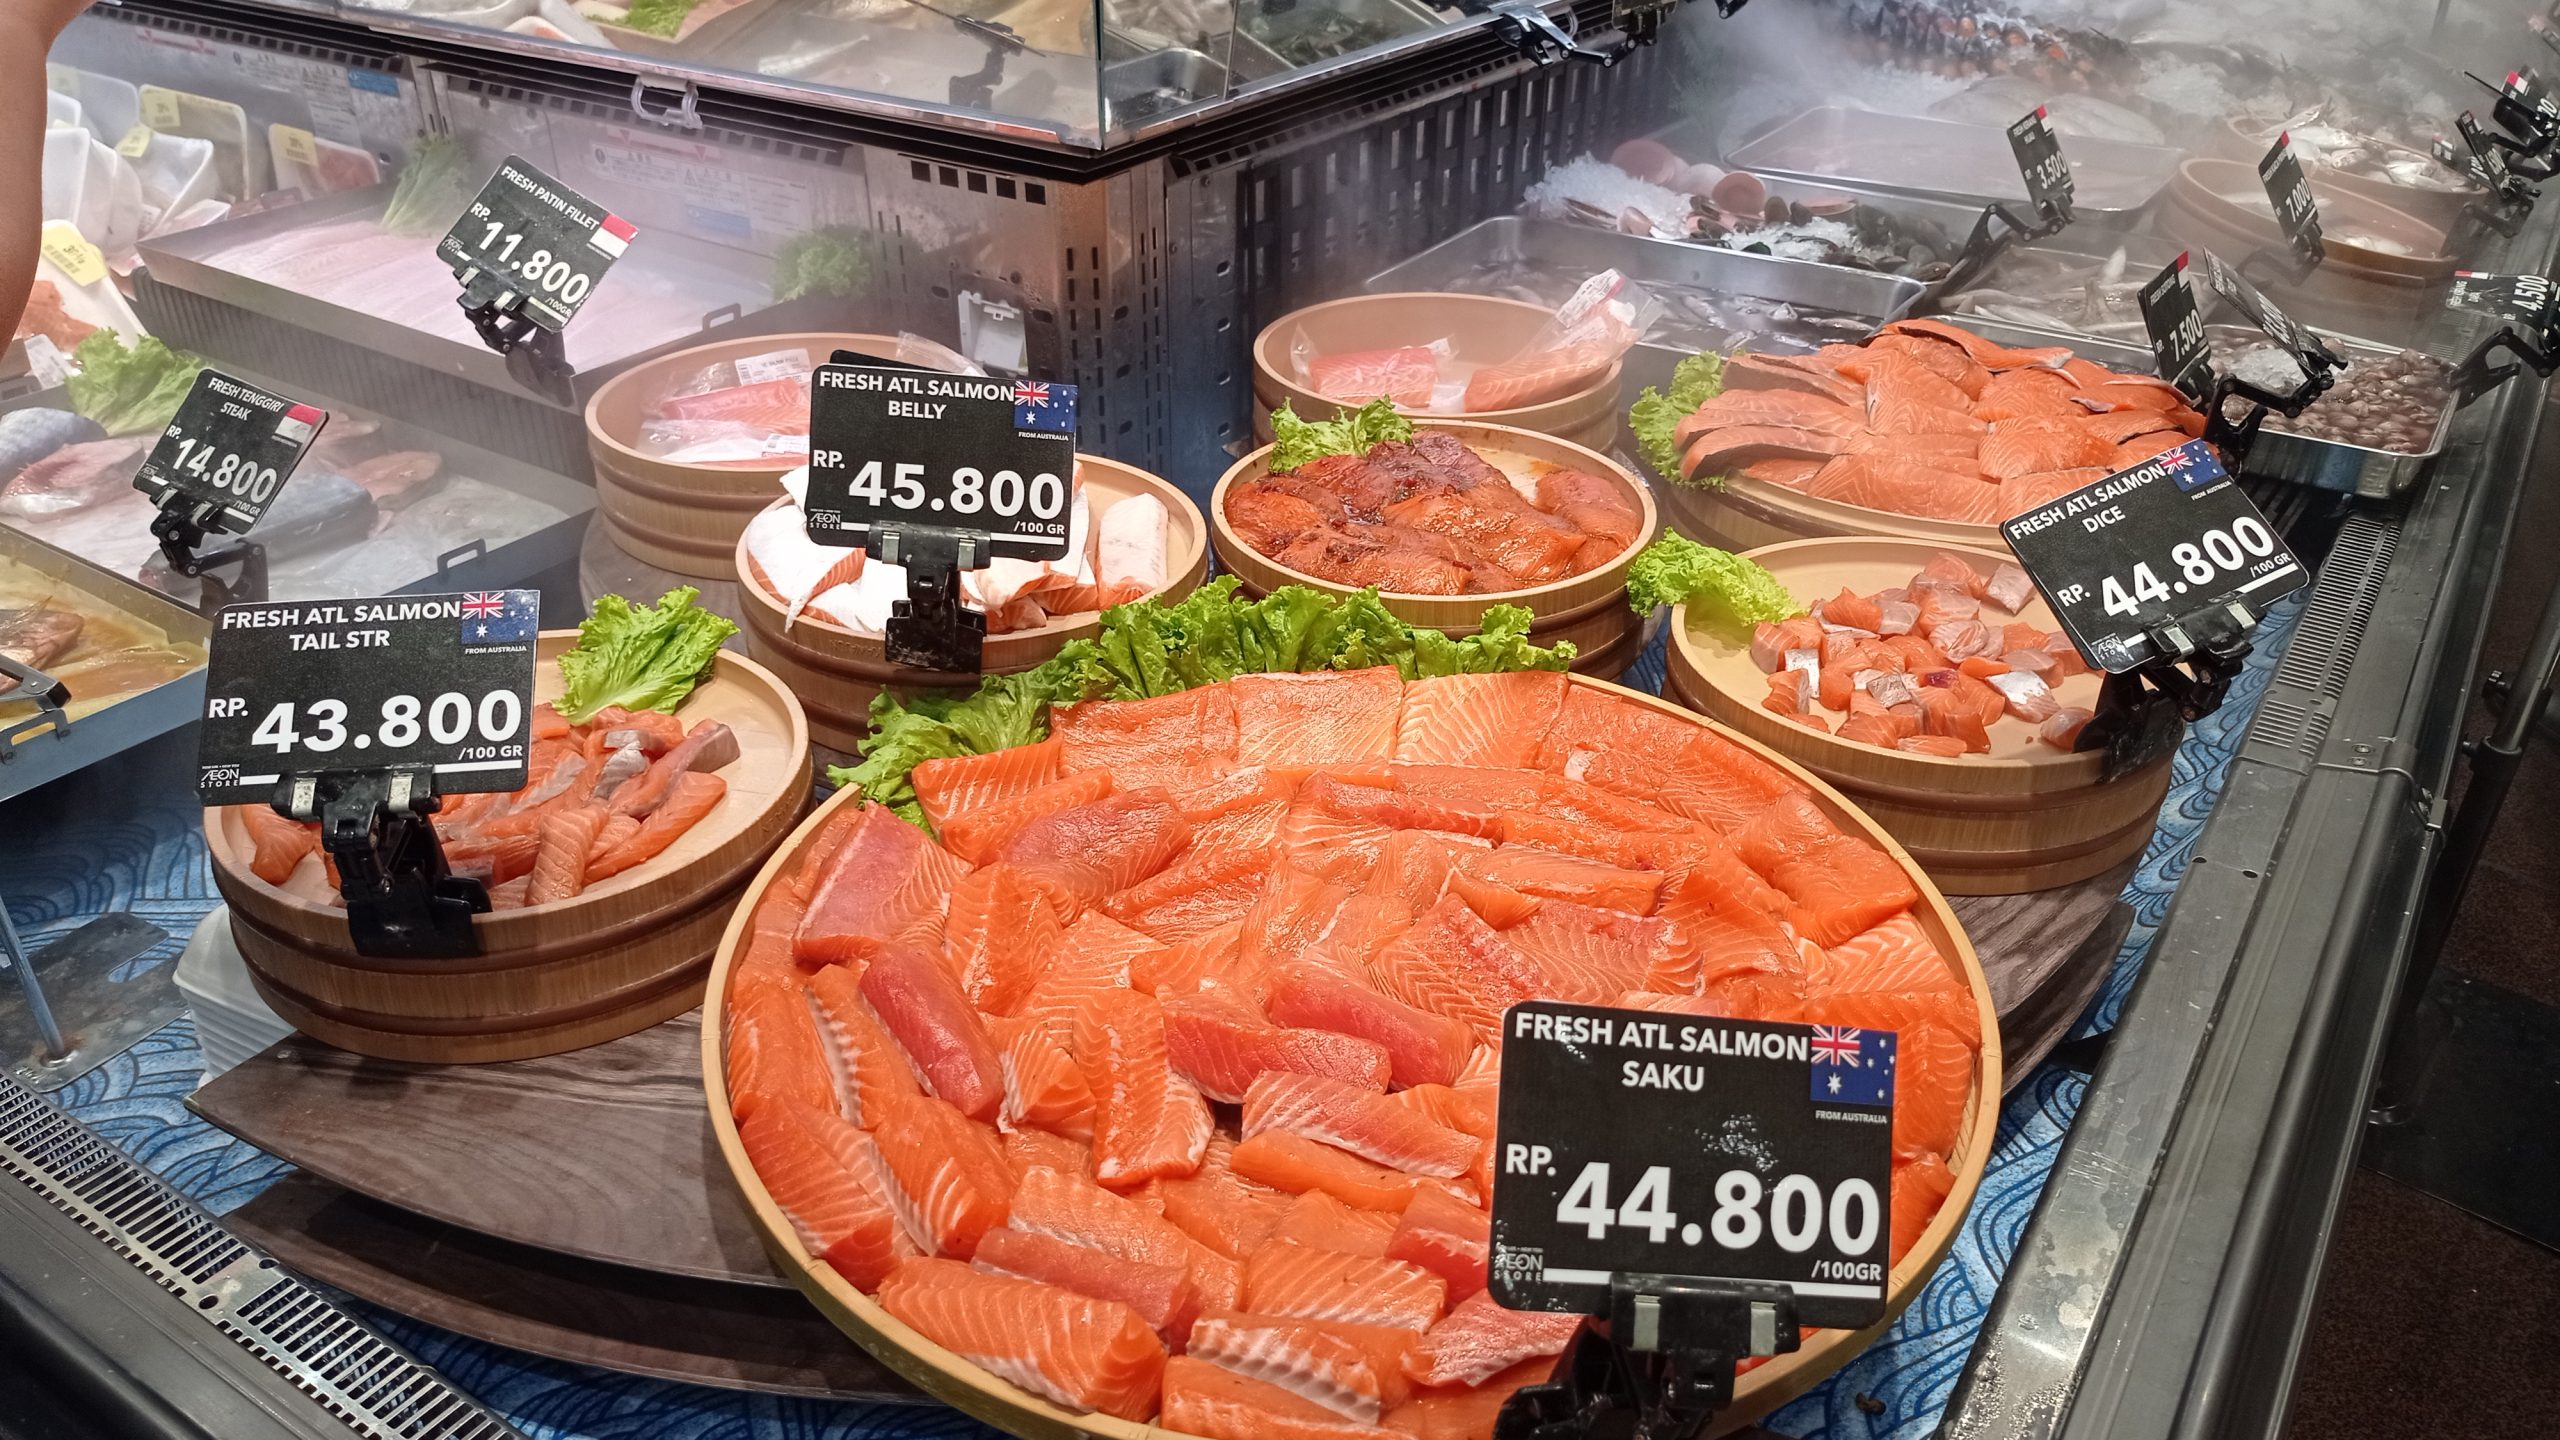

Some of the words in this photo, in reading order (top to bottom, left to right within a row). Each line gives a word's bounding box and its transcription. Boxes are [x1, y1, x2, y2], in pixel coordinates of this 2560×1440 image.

[2037, 150, 2067, 189] 3.500
[470, 202, 492, 221] RP.
[501, 166, 537, 194] FRESH
[534, 187, 567, 212] PATIN
[565, 203, 600, 231] FILLET
[2285, 177, 2310, 223] 7.000
[479, 221, 590, 304] 11.800
[2511, 274, 2549, 311] 4.500
[2169, 309, 2203, 362] 7.500
[208, 377, 240, 396] FRESH
[240, 388, 285, 412] TENGGIRI
[819, 371, 883, 392] FRESH
[887, 376, 924, 396] ATL
[927, 379, 1014, 402] SALMON
[220, 401, 252, 421] STEAK
[888, 400, 947, 420] BELLY
[166, 425, 182, 439] RP.
[1018, 431, 1036, 439] FROM
[1037, 433, 1069, 441] AUSTRALIA
[173, 438, 277, 504] 14.800
[813, 449, 846, 469] RP.
[848, 460, 1065, 520] 45.800
[2009, 506, 2065, 540] FRESH
[2065, 493, 2098, 518] ATL
[2096, 462, 2169, 504] SALMON
[810, 522, 841, 530] STORE
[1014, 520, 1044, 534] /100
[1046, 523, 1065, 535] GR
[2081, 505, 2126, 534] DICE
[2101, 516, 2275, 617] 44.800
[2249, 559, 2274, 579] /100
[2273, 552, 2293, 569] GR
[2057, 583, 2091, 607] RP.
[222, 608, 299, 630] FRESH
[304, 606, 349, 626] ATL
[353, 601, 460, 623] SALMON
[289, 633, 341, 651] TAIL
[346, 630, 391, 648] STR
[465, 647, 487, 655] FROM
[487, 645, 527, 654] AUSTRALIA
[208, 697, 249, 718] RP.
[251, 689, 522, 754] 43.800
[458, 746, 496, 761] /100
[500, 744, 523, 758] GR
[200, 780, 239, 789] STORE
[1515, 1012, 1613, 1046] FRESH
[1619, 1020, 1673, 1052] ATL
[1679, 1025, 1808, 1062] SALMON
[1621, 1059, 1705, 1092] SAKU
[1815, 1109, 1842, 1121] FROM
[1841, 1112, 1888, 1124] AUSTRALIA
[1505, 1143, 1557, 1177] RP.
[1556, 1161, 1880, 1257] 44.800
[1811, 1260, 1882, 1281] /100GR
